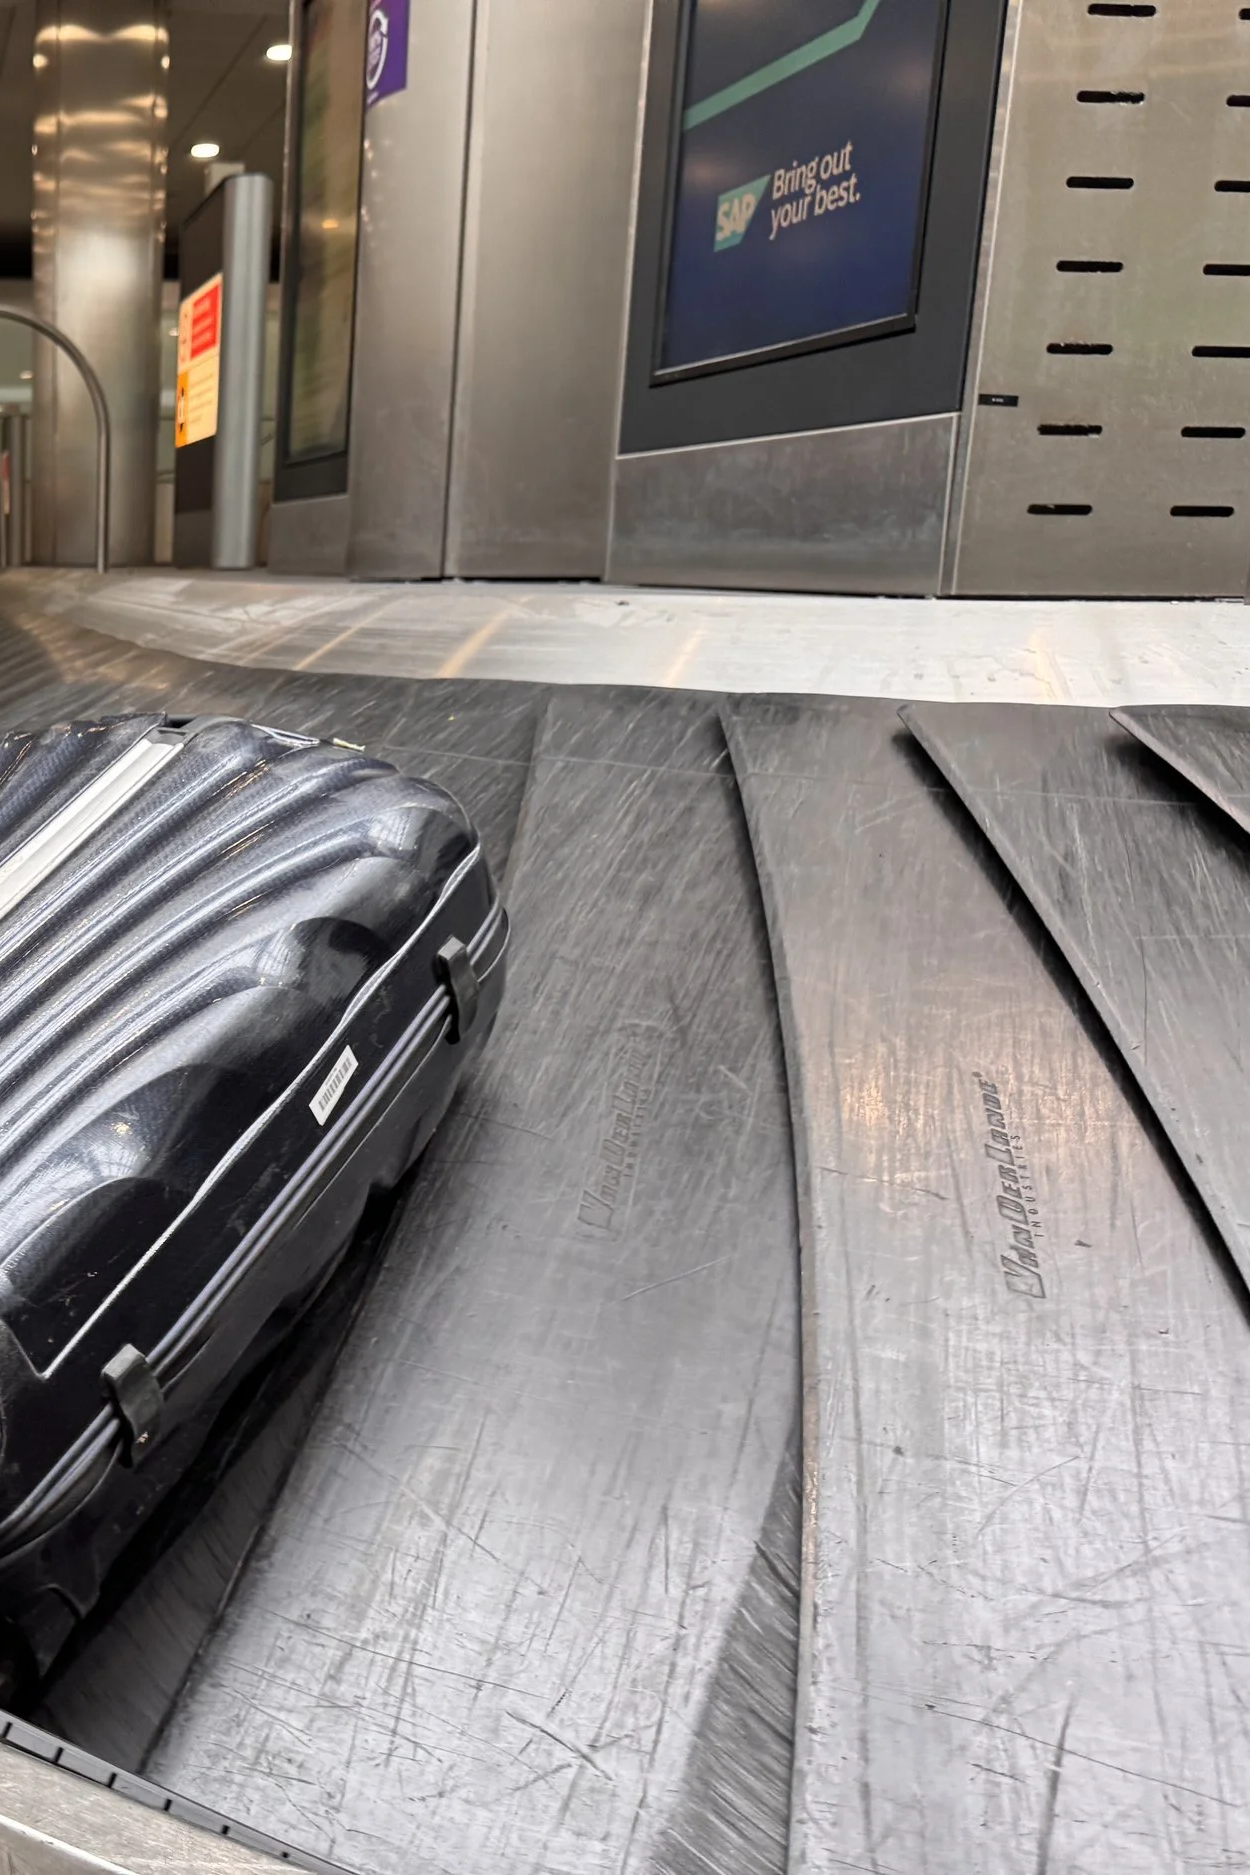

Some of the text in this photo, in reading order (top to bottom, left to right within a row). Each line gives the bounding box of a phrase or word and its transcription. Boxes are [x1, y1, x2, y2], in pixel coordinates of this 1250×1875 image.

[772, 139, 853, 200] Bring out
[715, 194, 757, 241] SAP
[768, 173, 861, 241] your best.
[1010, 1134, 1045, 1238] INDUSTRIES
